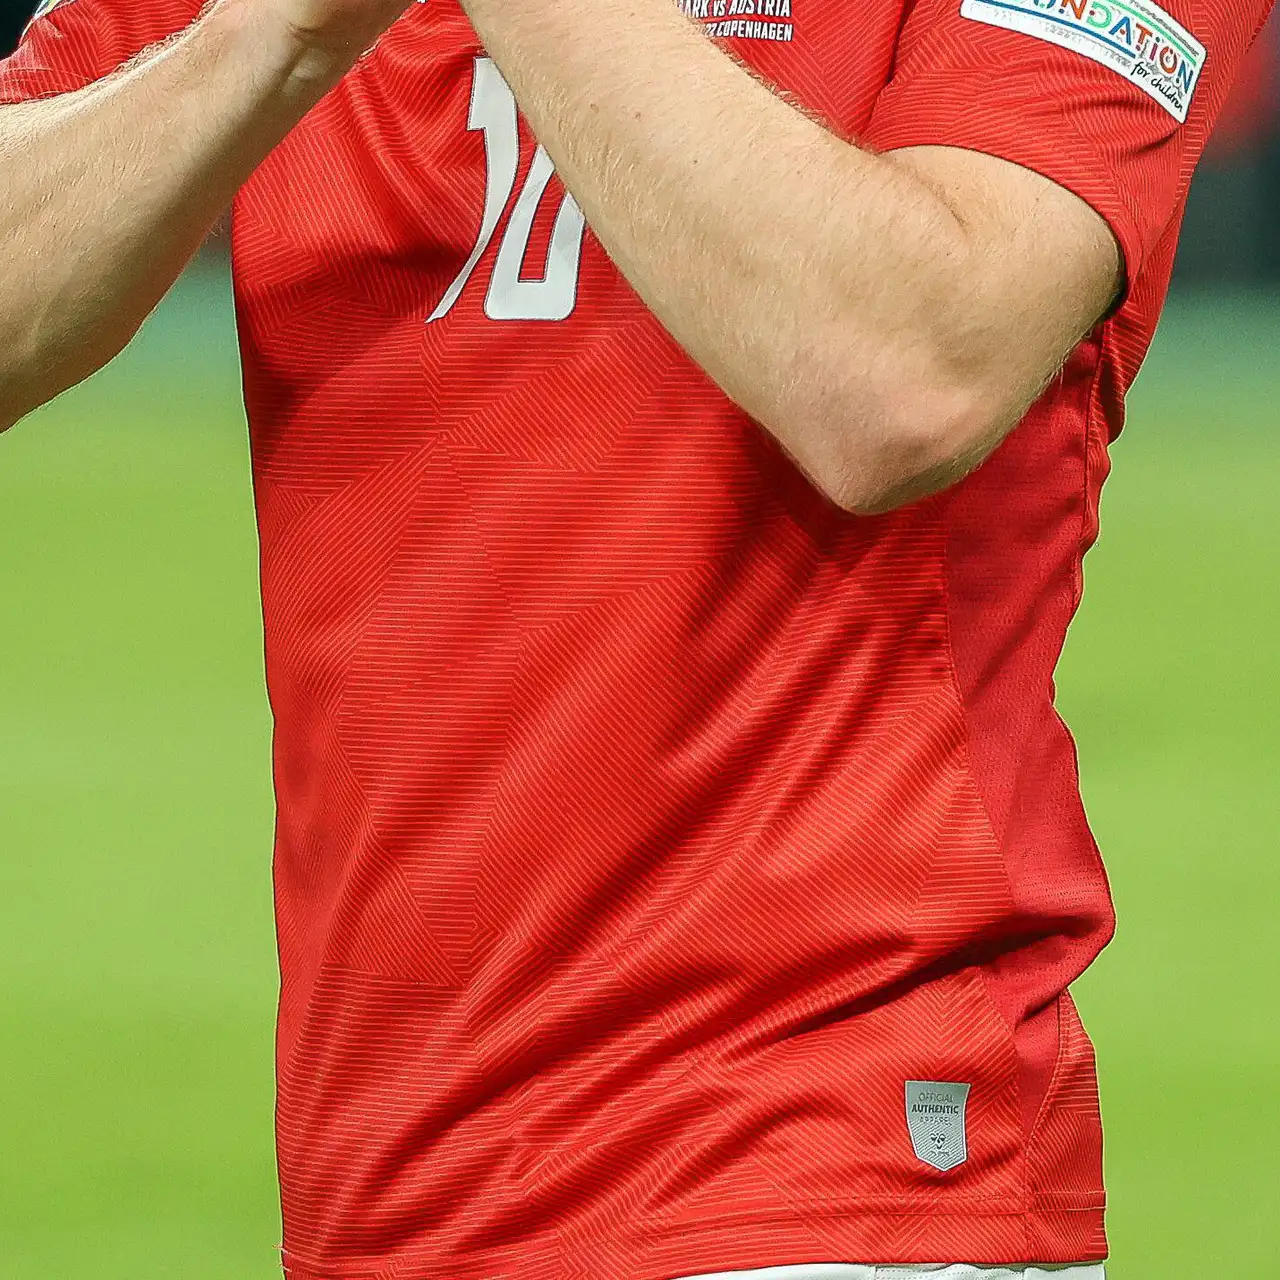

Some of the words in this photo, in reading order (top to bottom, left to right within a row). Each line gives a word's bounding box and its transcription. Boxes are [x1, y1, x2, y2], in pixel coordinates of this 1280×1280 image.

[717, 20, 793, 41] COPENHAGEN
[1130, 61, 1152, 79] for
[1150, 76, 1184, 113] children
[424, 56, 587, 324] 10
[918, 1092, 954, 1103] OFFICIAL
[911, 1104, 960, 1116] AUTHENTIC
